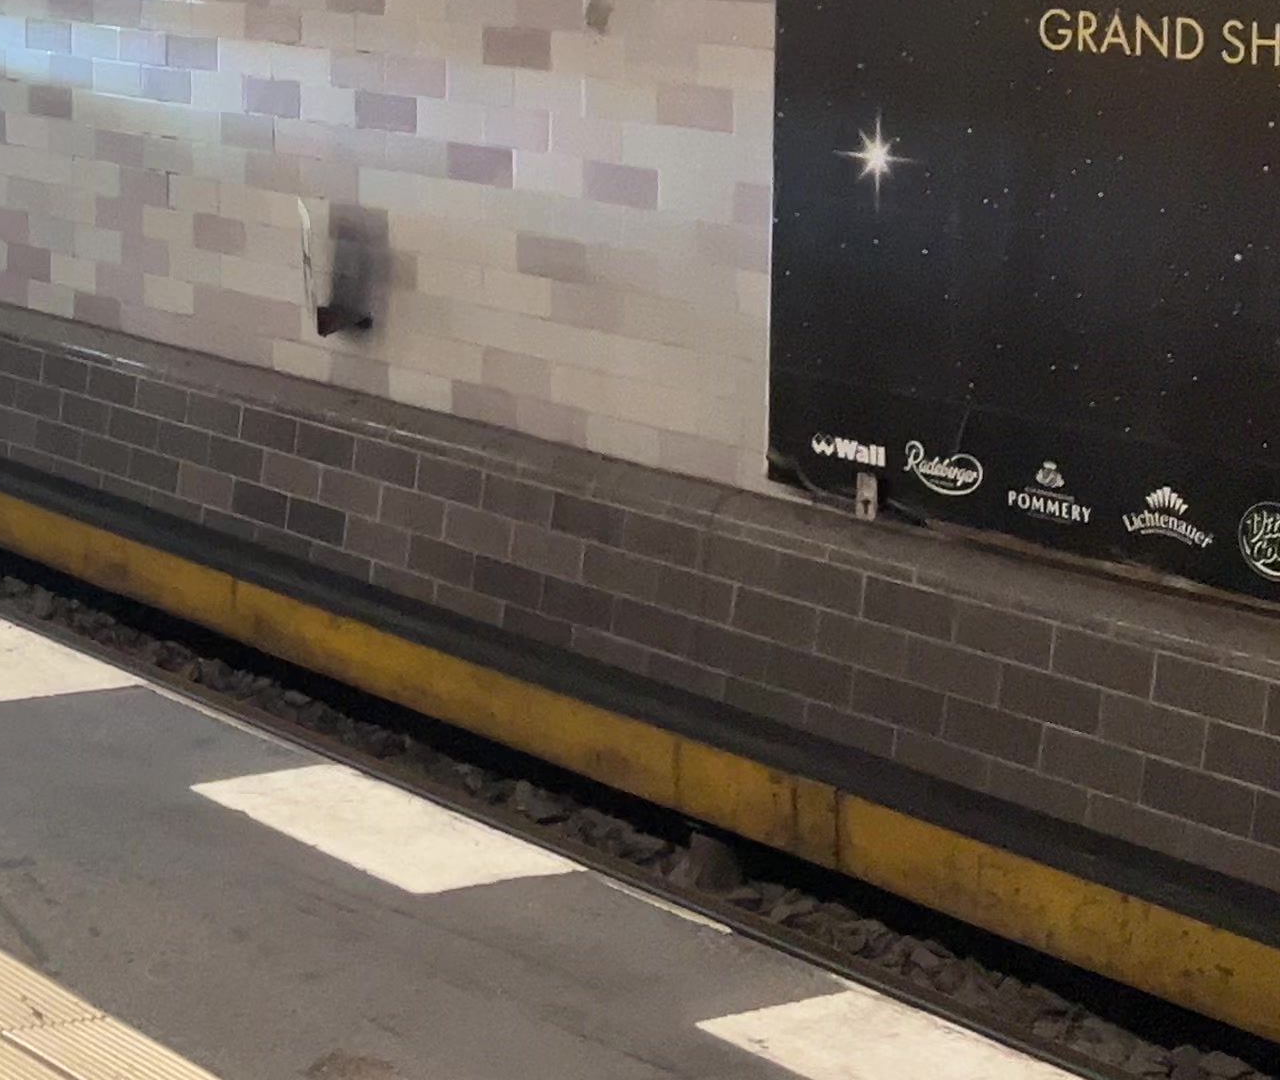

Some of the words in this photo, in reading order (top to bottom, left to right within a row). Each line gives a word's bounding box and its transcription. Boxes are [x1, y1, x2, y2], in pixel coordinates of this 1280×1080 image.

[1039, 8, 1205, 61] GRAND
[835, 437, 886, 468] Wall
[1007, 490, 1092, 524] POMMERY
[1121, 508, 1215, 549] Lichtenauer
